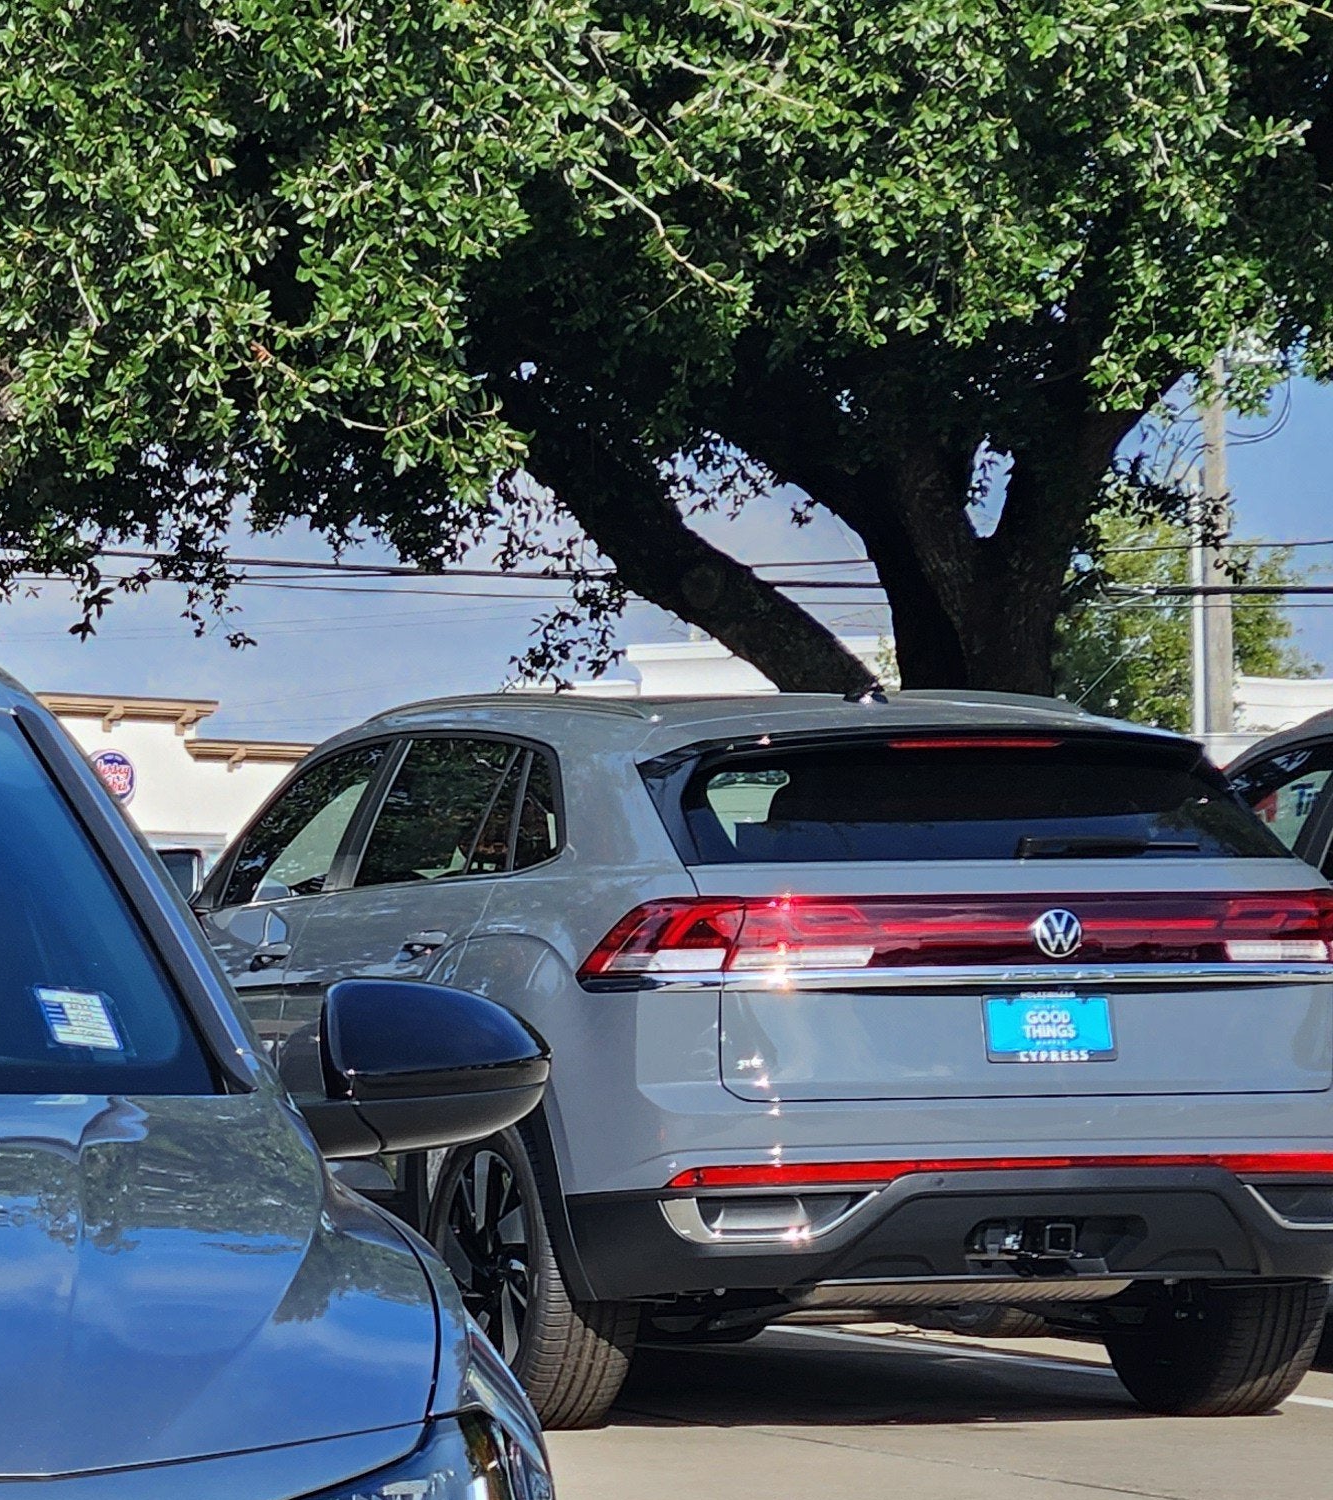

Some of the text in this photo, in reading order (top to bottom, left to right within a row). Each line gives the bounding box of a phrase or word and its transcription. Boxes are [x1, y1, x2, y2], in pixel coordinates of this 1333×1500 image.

[1025, 1010, 1071, 1024] GOOD
[1023, 1024, 1076, 1039] THINGS
[1019, 1050, 1090, 1062] CYPRESS
